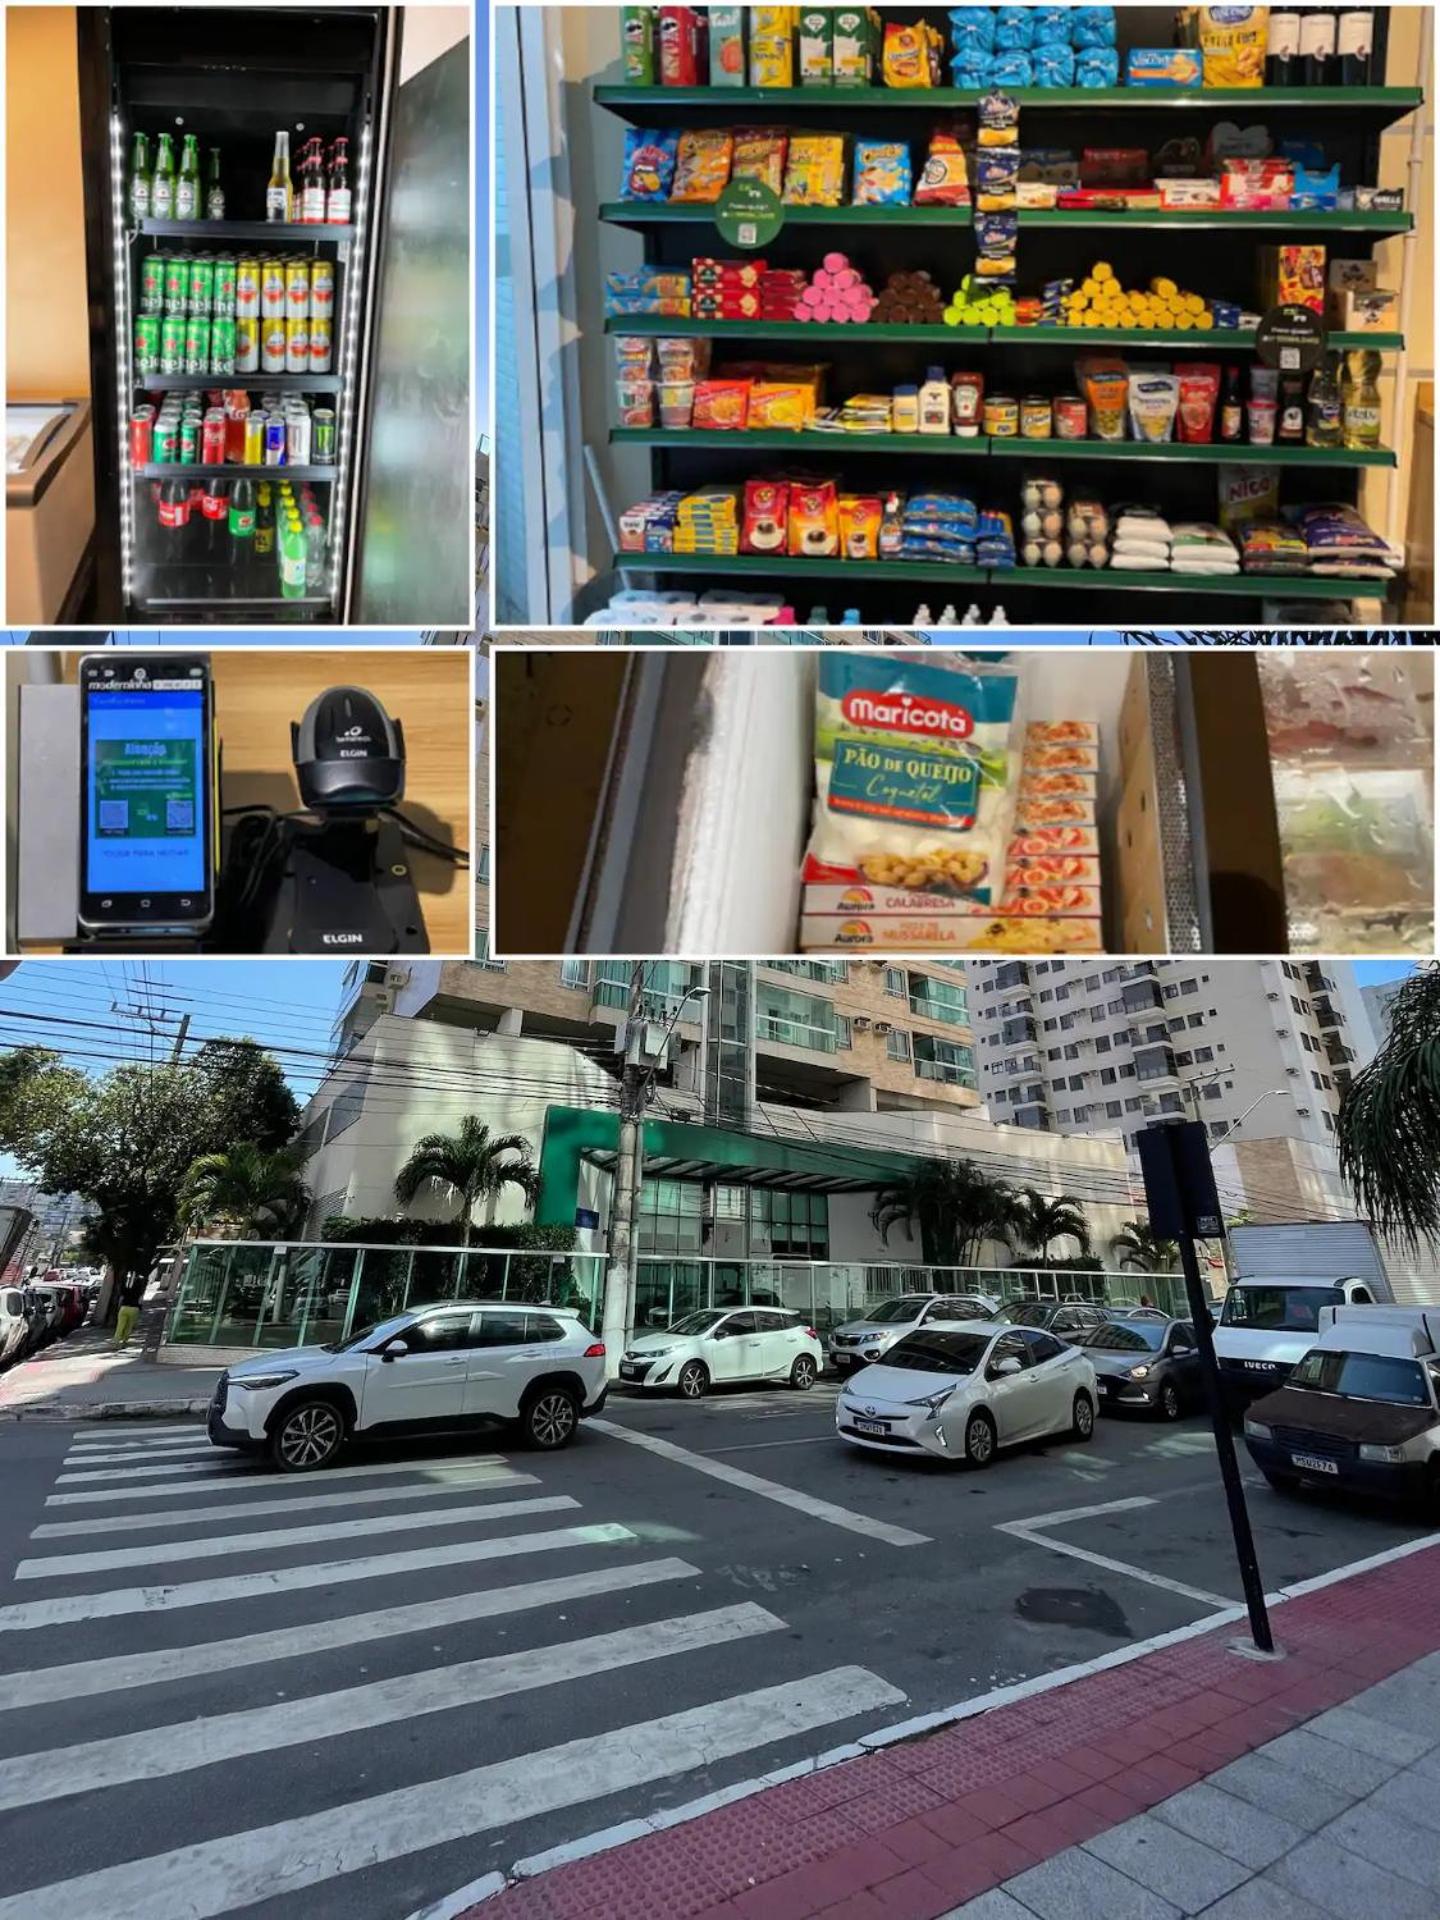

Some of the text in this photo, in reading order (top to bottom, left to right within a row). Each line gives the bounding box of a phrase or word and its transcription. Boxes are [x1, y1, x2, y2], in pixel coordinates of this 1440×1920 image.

[850, 696, 966, 733] Maricota
[340, 748, 368, 758] ELGIN
[844, 748, 880, 769] PÃO
[907, 760, 972, 784] QUEIJO
[323, 933, 363, 944] ELGIN
[834, 933, 874, 944] Aurora
